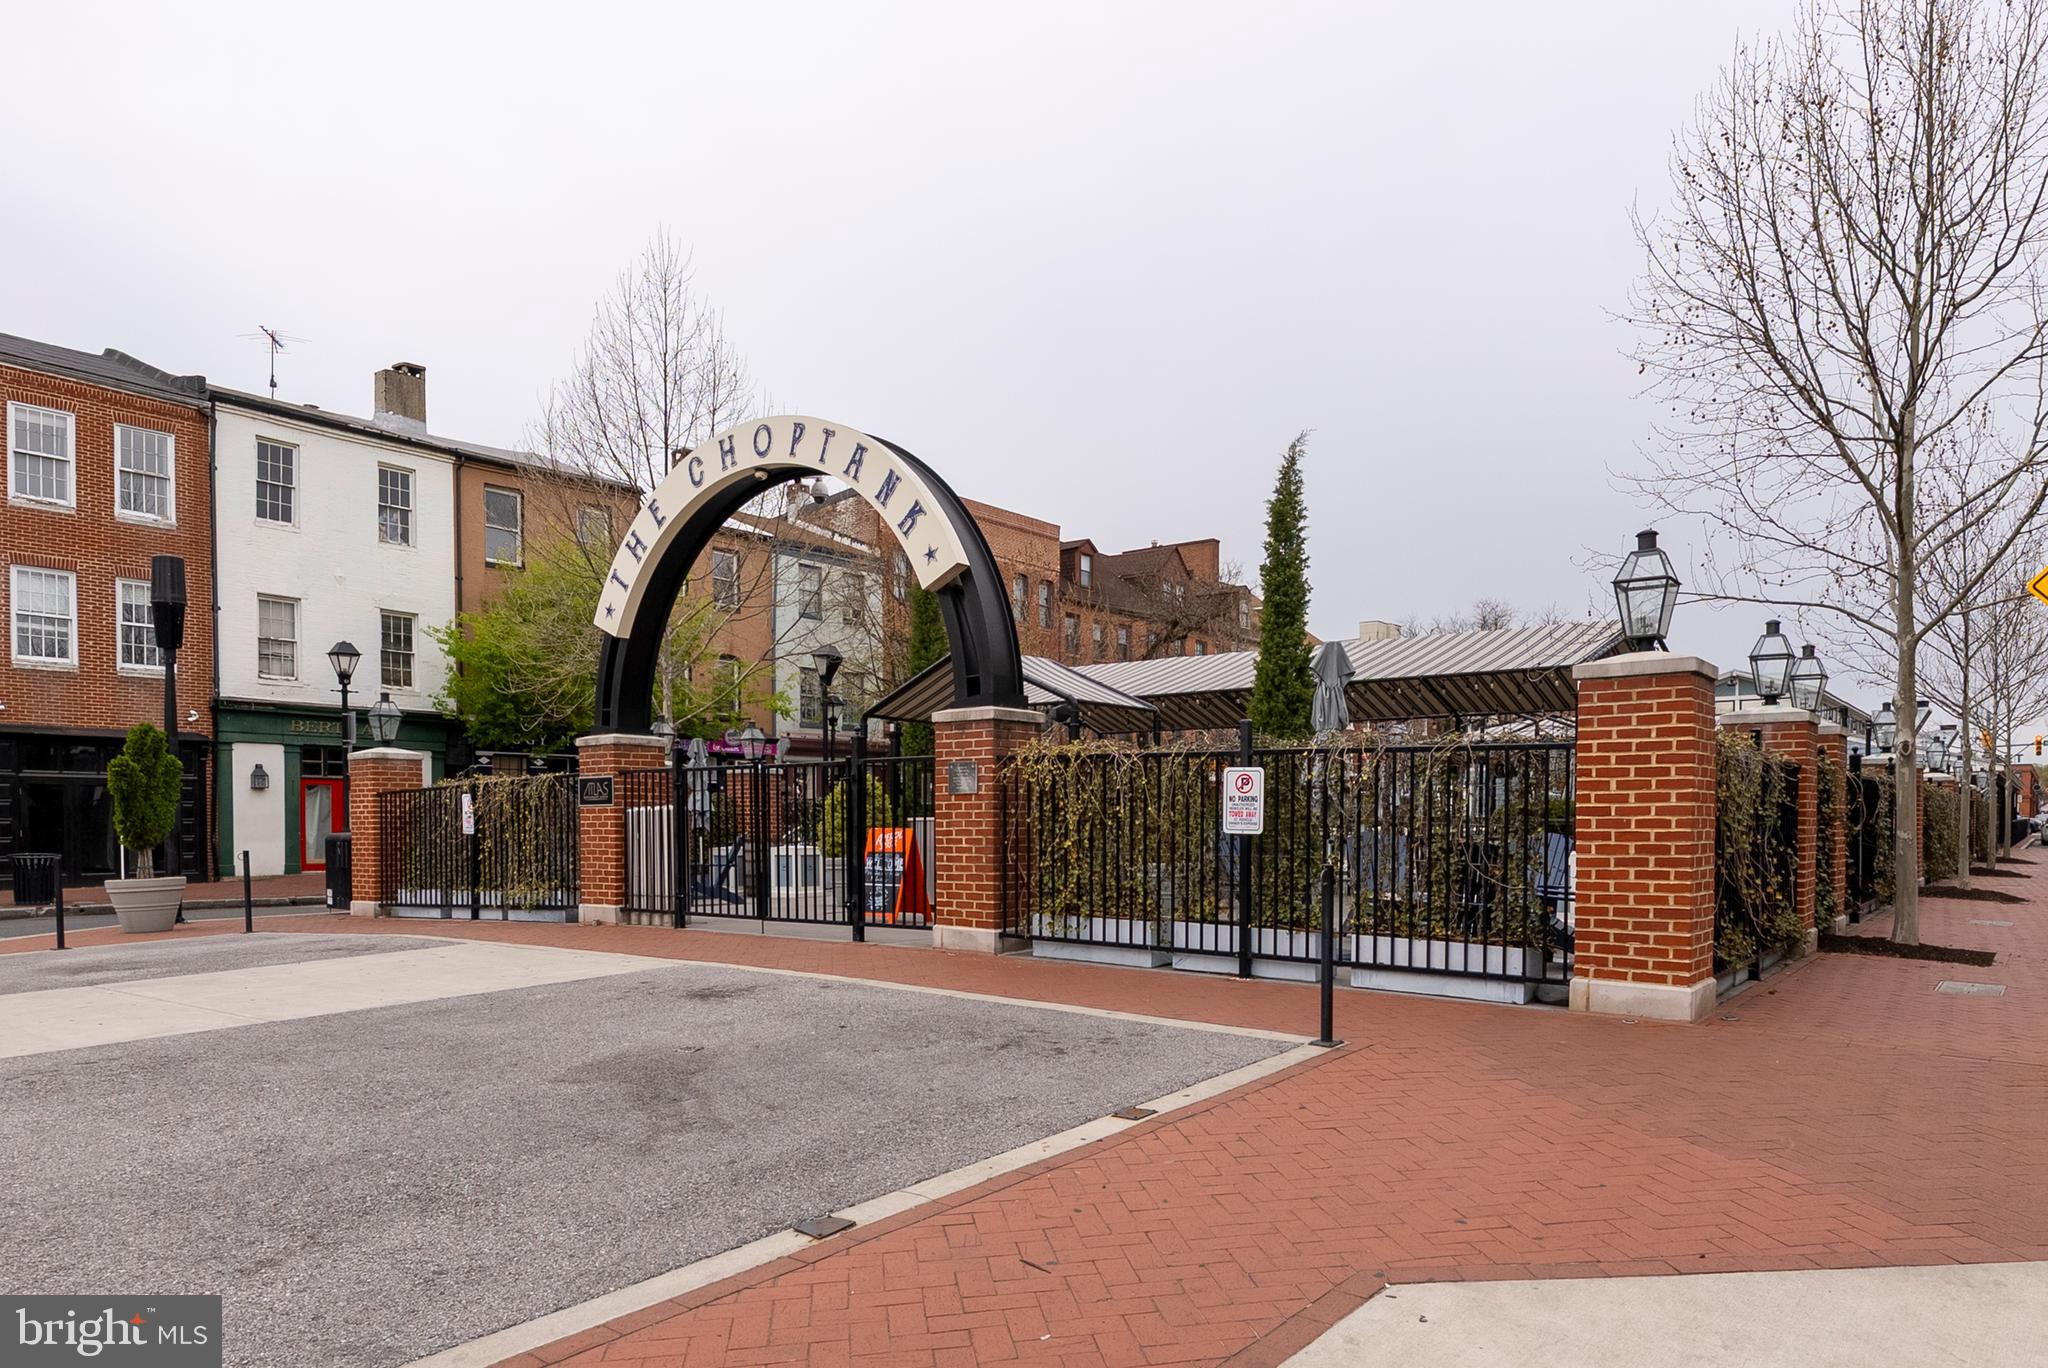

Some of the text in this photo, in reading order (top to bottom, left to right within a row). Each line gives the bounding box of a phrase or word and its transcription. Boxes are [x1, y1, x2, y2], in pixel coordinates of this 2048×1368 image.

[609, 422, 927, 593] THE CHOPTANK
[584, 782, 608, 796] ATLAS
